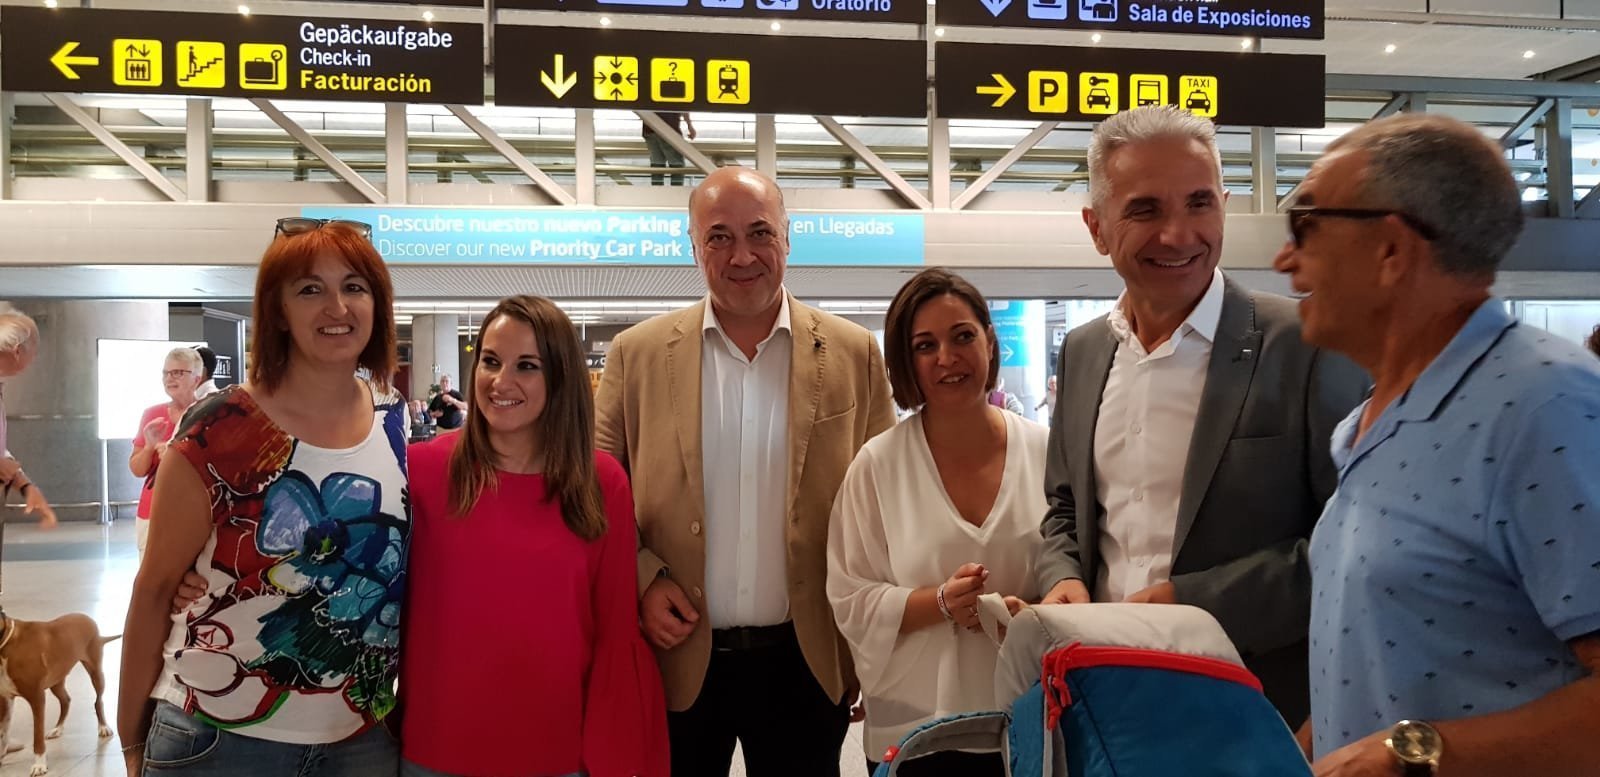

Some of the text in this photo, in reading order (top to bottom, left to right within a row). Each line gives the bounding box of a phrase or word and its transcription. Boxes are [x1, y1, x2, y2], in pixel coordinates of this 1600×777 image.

[1128, 4, 1311, 29] Sala de Exposiciones
[299, 22, 453, 50] Gepäckaufgabe
[300, 48, 371, 66] Check-in
[301, 69, 431, 92] Facturación
[1187, 78, 1210, 88] TAXI
[1040, 78, 1059, 106] P
[378, 214, 464, 232] Descubre
[469, 218, 539, 232] nuestro
[544, 219, 602, 232] nuevo
[607, 215, 682, 236] Parking
[793, 217, 895, 238] en Llegadas
[379, 239, 453, 257] Discover
[456, 243, 484, 257] our
[490, 243, 526, 257] new
[530, 239, 601, 260] Priority
[605, 239, 636, 257] Car
[641, 239, 682, 257] Park
